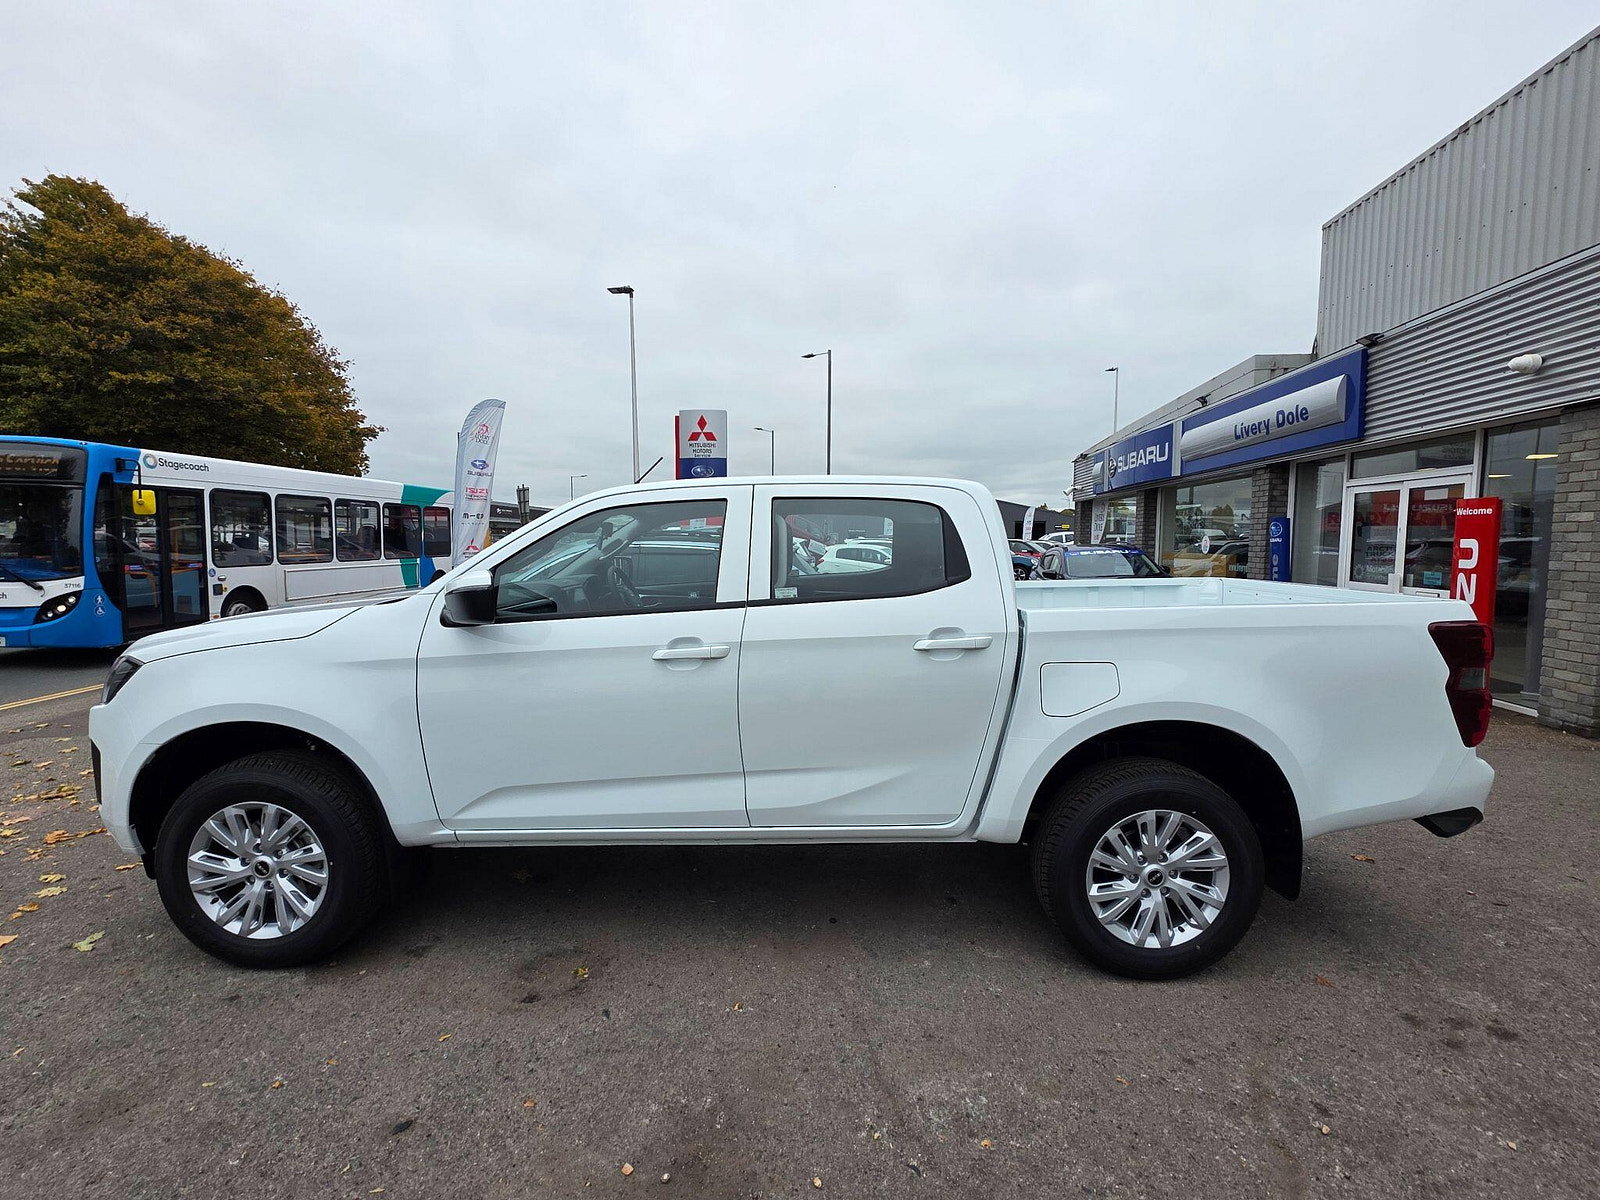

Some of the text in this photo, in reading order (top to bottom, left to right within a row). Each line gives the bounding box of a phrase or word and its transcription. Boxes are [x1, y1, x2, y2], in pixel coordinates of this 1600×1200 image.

[1234, 405, 1309, 440] Livery Dole
[158, 458, 209, 472] Stagecoach
[1117, 442, 1169, 473] SUBARU
[1456, 507, 1493, 516] Welcome
